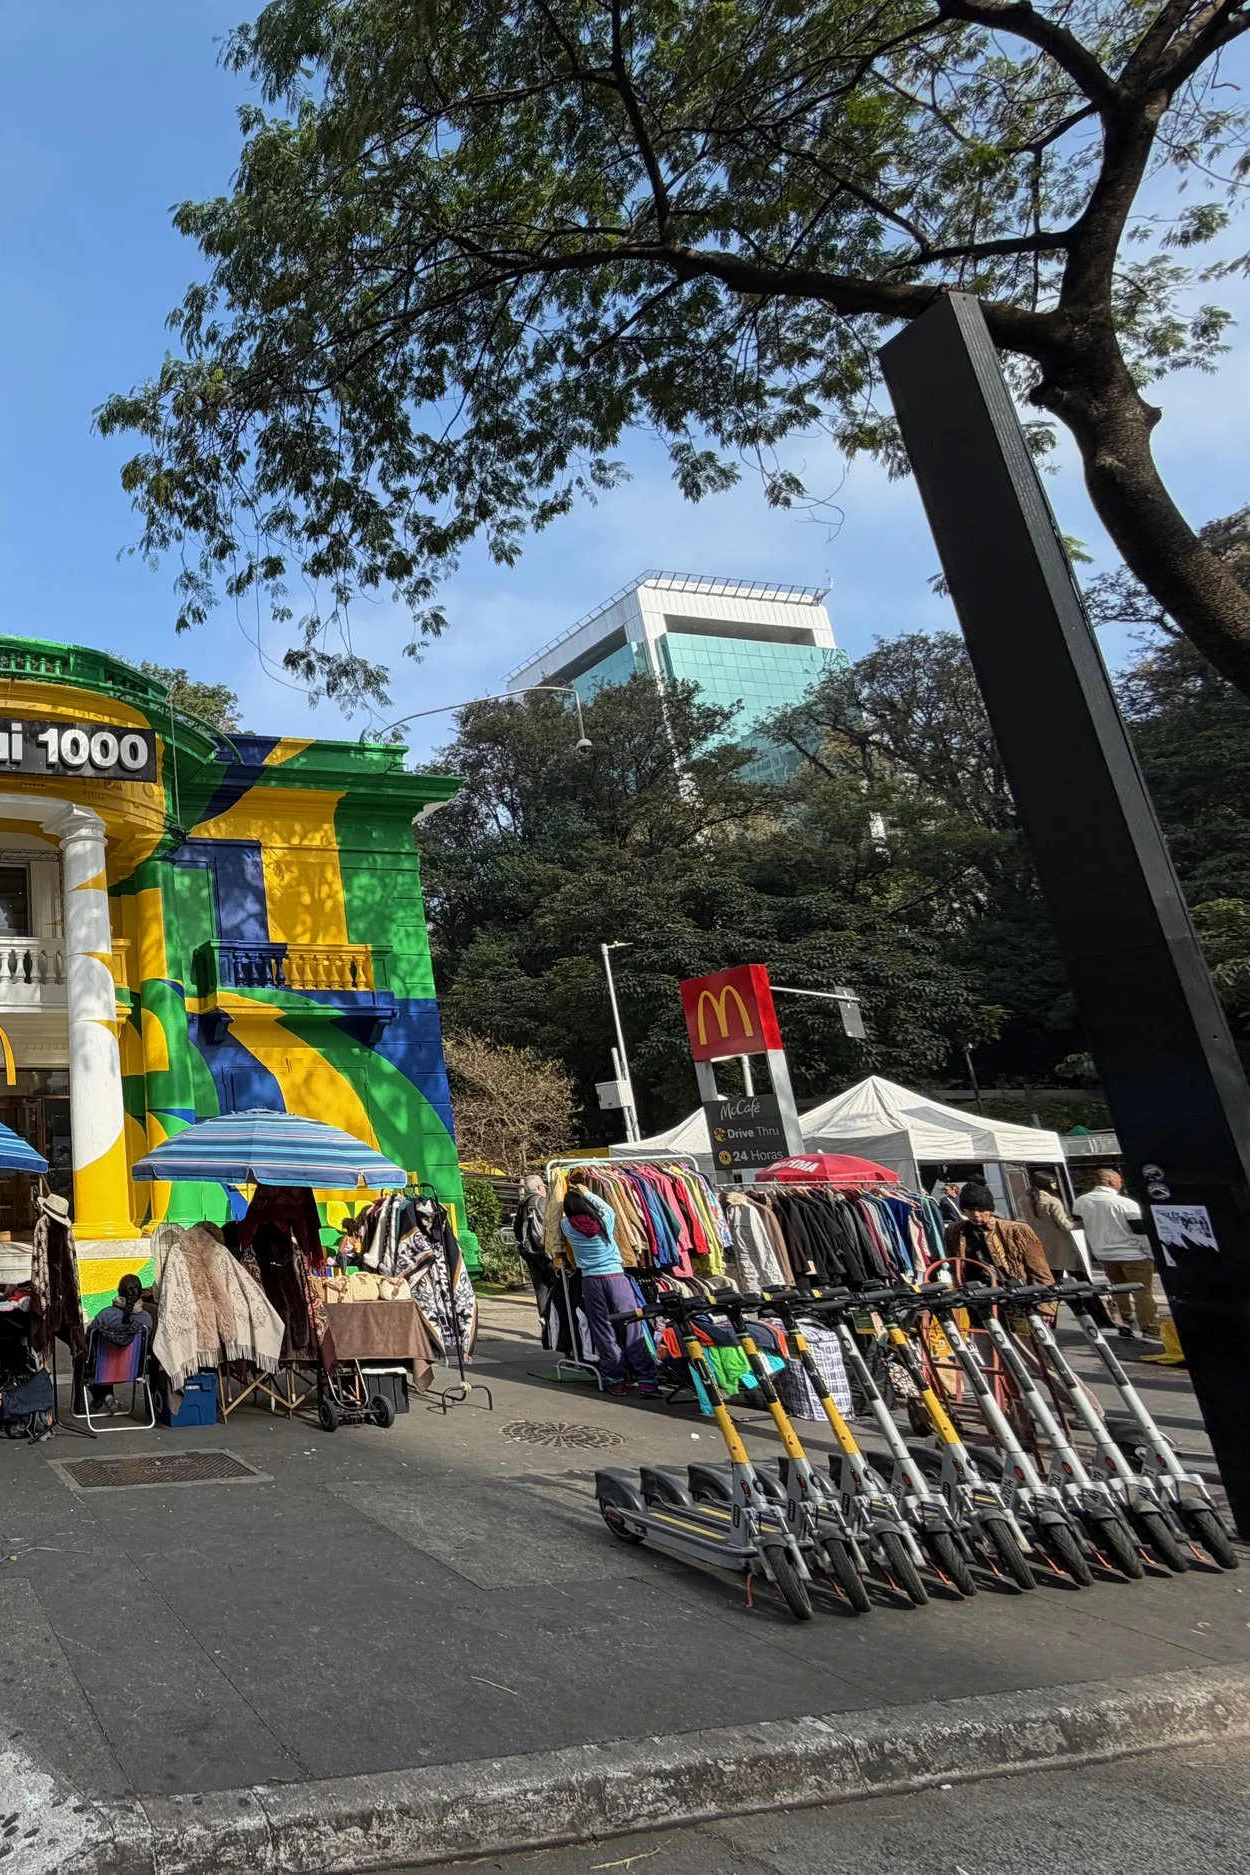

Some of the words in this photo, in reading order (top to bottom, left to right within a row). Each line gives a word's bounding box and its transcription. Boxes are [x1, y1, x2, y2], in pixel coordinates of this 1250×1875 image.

[37, 728, 150, 772] 1000
[720, 1098, 761, 1121] McCafé
[727, 1128, 754, 1139] Drive
[755, 1126, 780, 1136] Thru
[733, 1150, 748, 1162] 24
[750, 1150, 784, 1161] Horas
